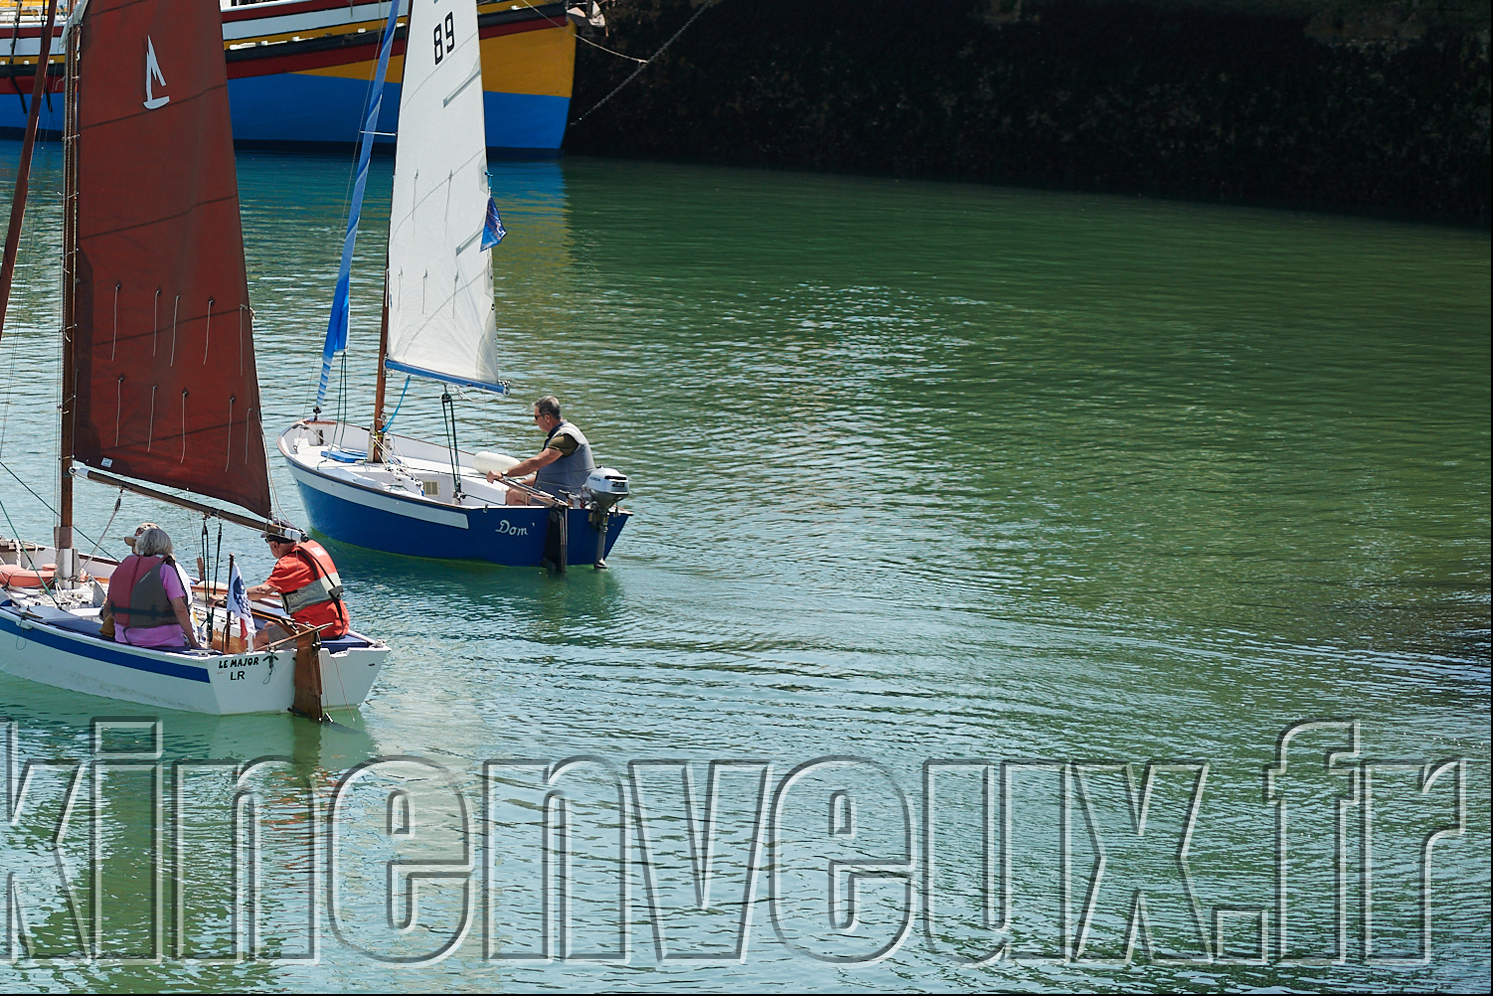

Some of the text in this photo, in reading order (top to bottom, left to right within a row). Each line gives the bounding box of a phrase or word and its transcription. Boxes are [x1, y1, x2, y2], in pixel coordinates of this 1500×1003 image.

[434, 11, 455, 65] 89
[218, 657, 259, 669] LE MAJOR
[230, 671, 246, 681] LR
